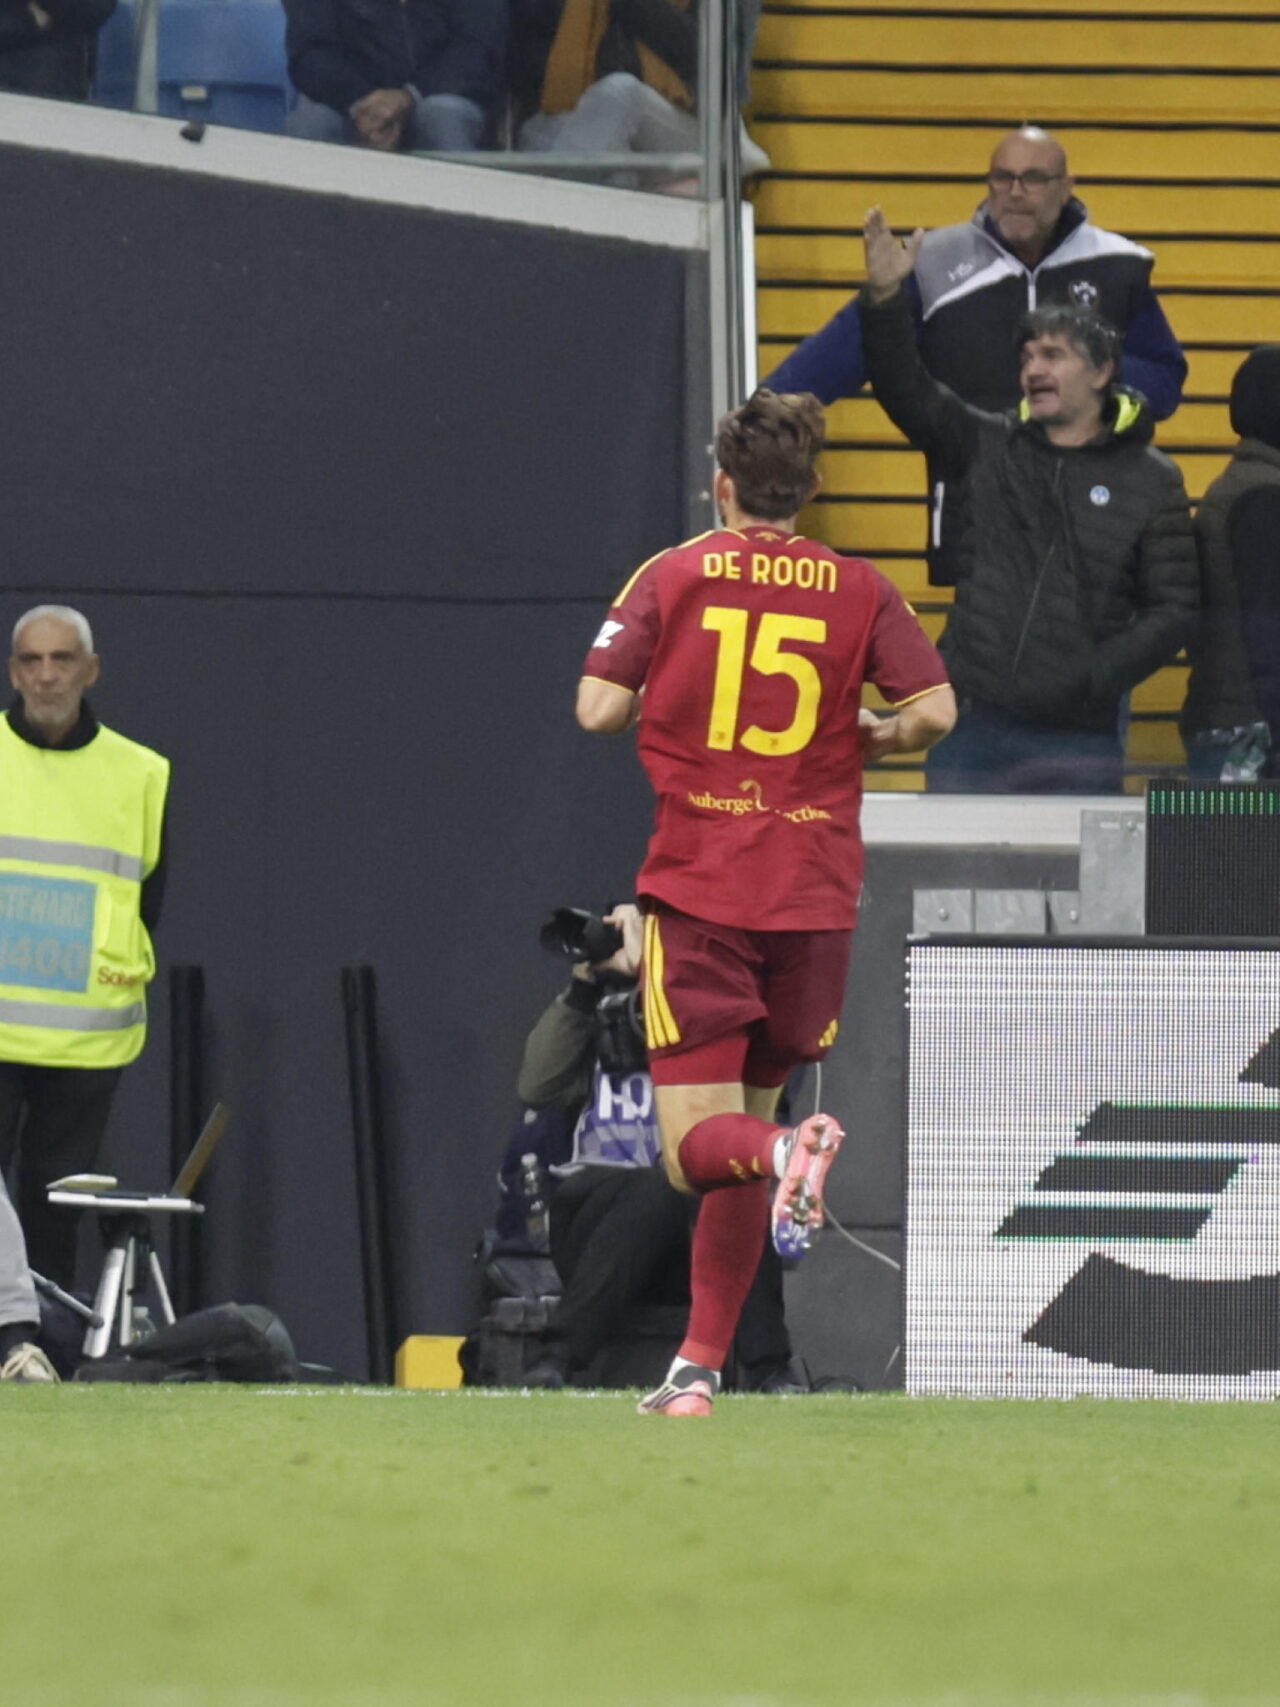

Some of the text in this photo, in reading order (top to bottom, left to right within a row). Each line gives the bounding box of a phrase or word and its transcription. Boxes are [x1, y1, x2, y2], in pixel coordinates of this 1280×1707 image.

[703, 551, 837, 592] DE ROON
[701, 606, 827, 756] 15
